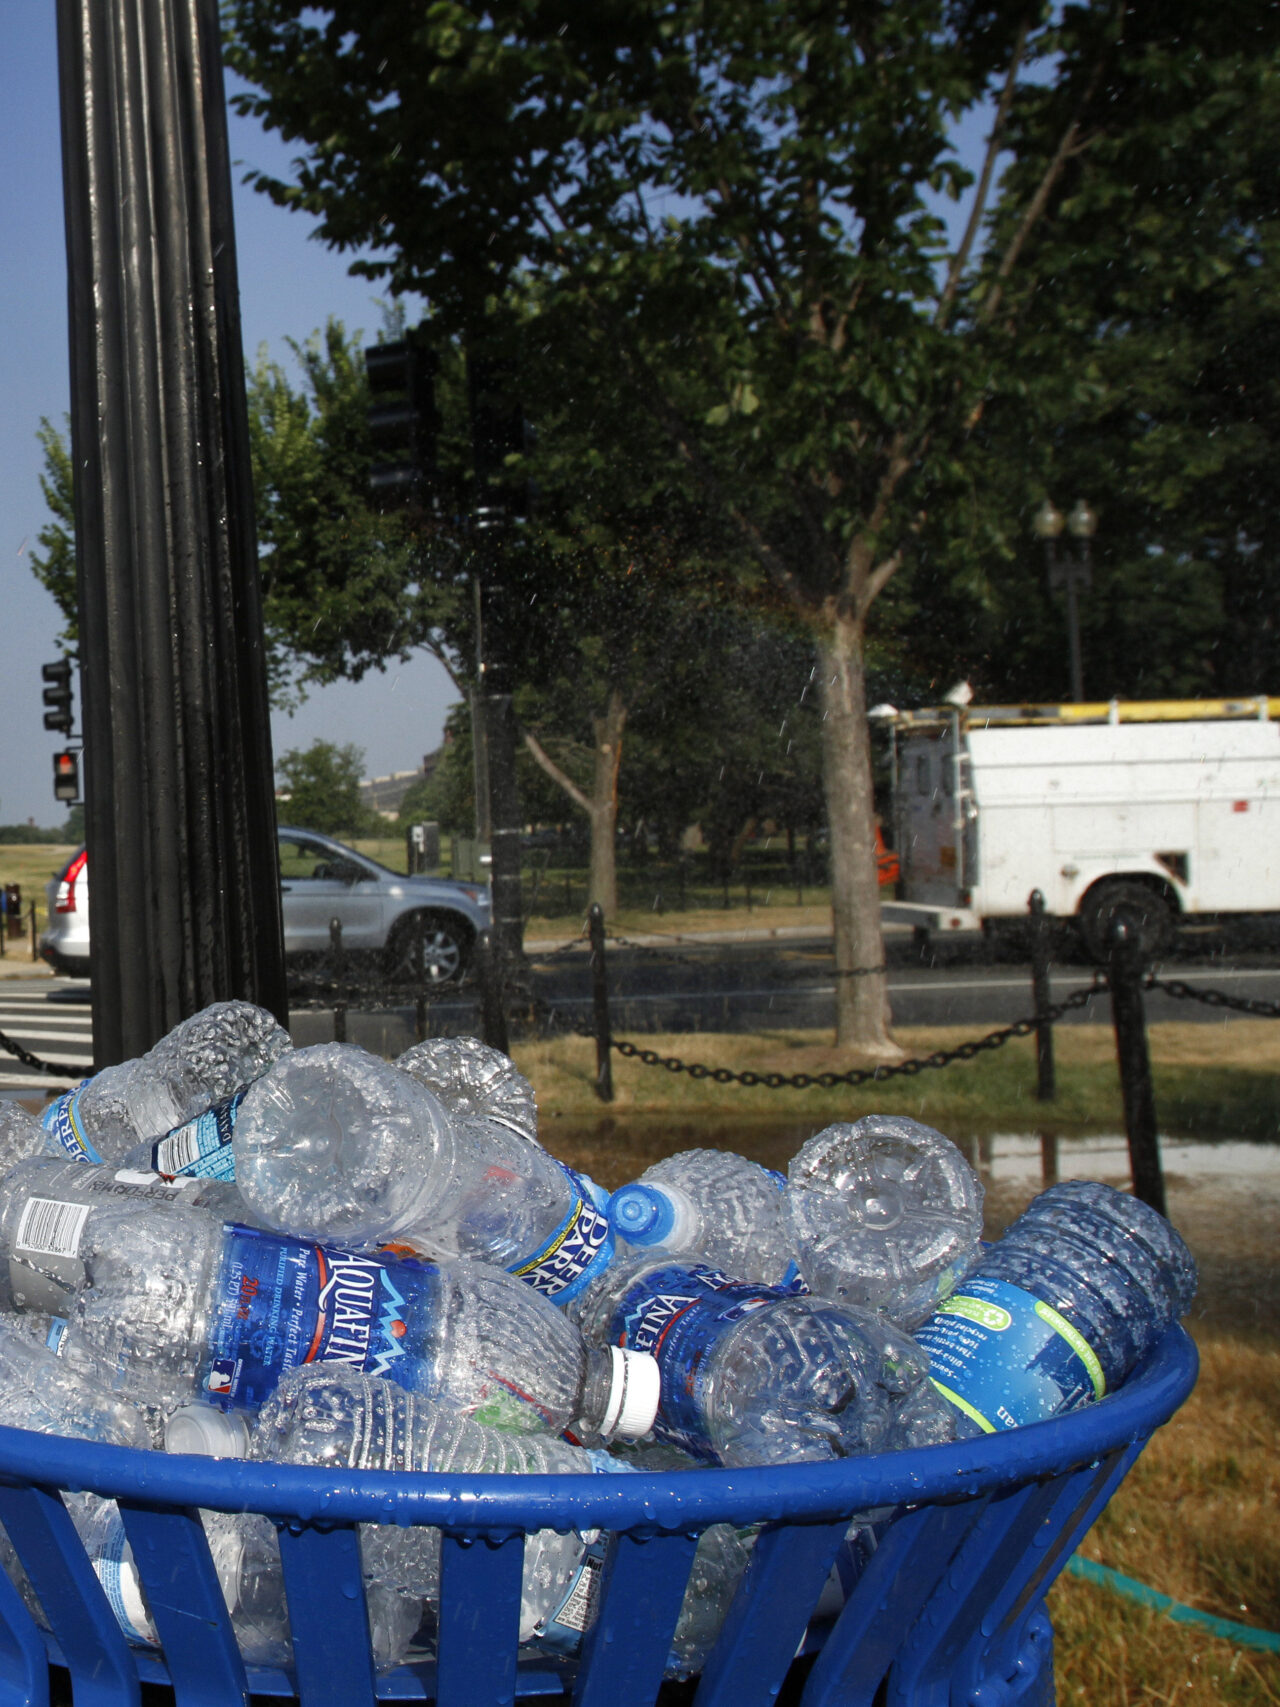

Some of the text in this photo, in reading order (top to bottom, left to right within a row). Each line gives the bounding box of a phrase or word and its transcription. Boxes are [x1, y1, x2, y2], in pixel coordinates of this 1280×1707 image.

[295, 1247, 311, 1268] Pure
[519, 1205, 597, 1288] PARK
[547, 1213, 609, 1296] DEER
[241, 1275, 259, 1296] 20
[262, 1246, 288, 1367] PURIFIED DRINKING WATER
[294, 1266, 308, 1302] Water
[318, 1246, 386, 1376] AQUAFIN
[287, 1306, 304, 1348] Perfect
[634, 1294, 702, 1352] FINA
